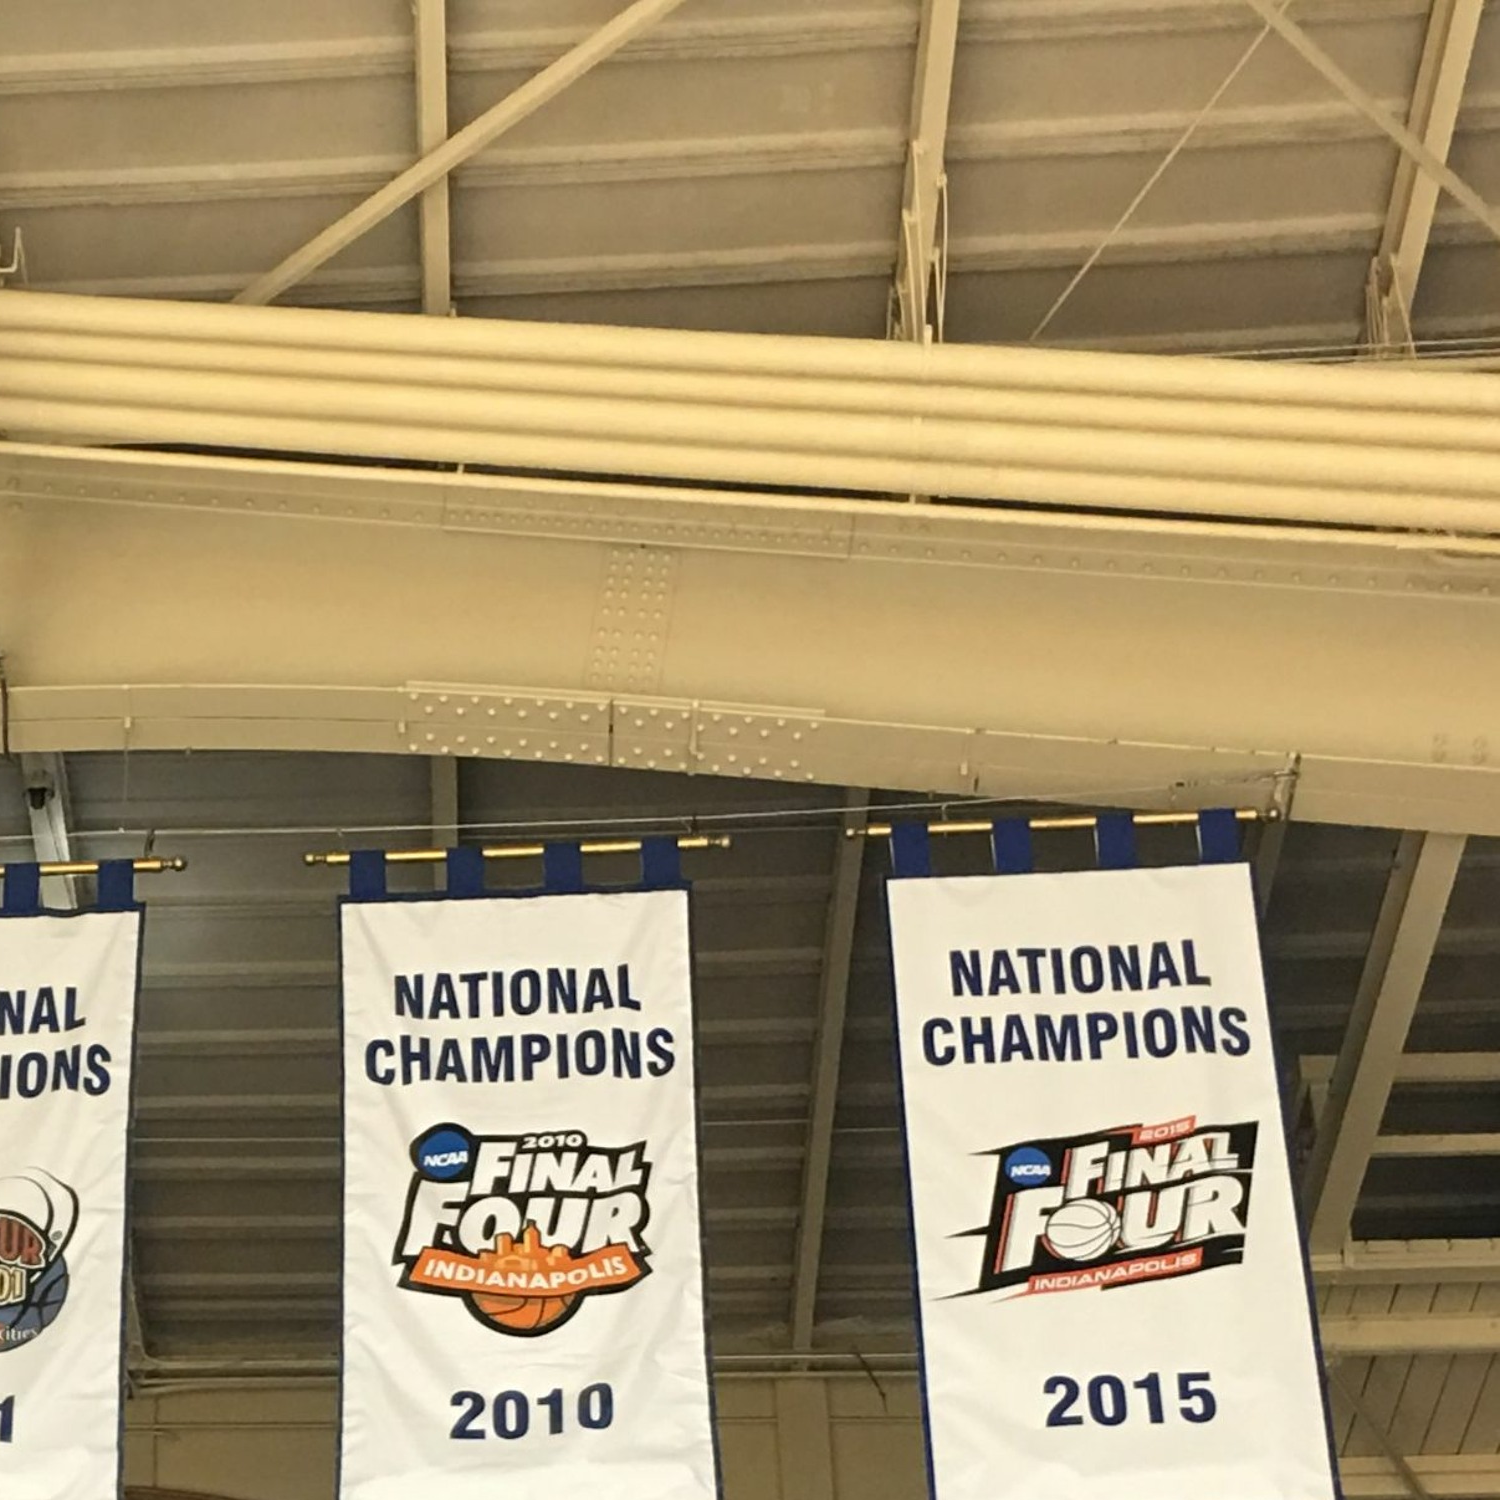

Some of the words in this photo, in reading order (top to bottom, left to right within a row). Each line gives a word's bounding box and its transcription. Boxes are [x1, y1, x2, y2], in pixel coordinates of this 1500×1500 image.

[395, 964, 641, 1019] NATIONAL
[950, 939, 1212, 996] NATIONAL
[365, 1028, 676, 1085] CHAMPIONS
[923, 1006, 1251, 1066] CHAMPIONS
[522, 1134, 583, 1149] 2010
[1139, 1120, 1191, 1141] 2015
[424, 1151, 469, 1167] NCAA
[470, 1141, 643, 1195] FINAL
[1010, 1163, 1051, 1177] NCAA
[1063, 1132, 1240, 1199] FINAL
[402, 1180, 642, 1257] FOUR
[1000, 1175, 1247, 1273] FOUR
[424, 1256, 628, 1289] INDIANAPOLIS
[1035, 1253, 1197, 1291] INDIANAPOLIS
[450, 1382, 613, 1439] 2010
[1043, 1372, 1217, 1428] 2015
